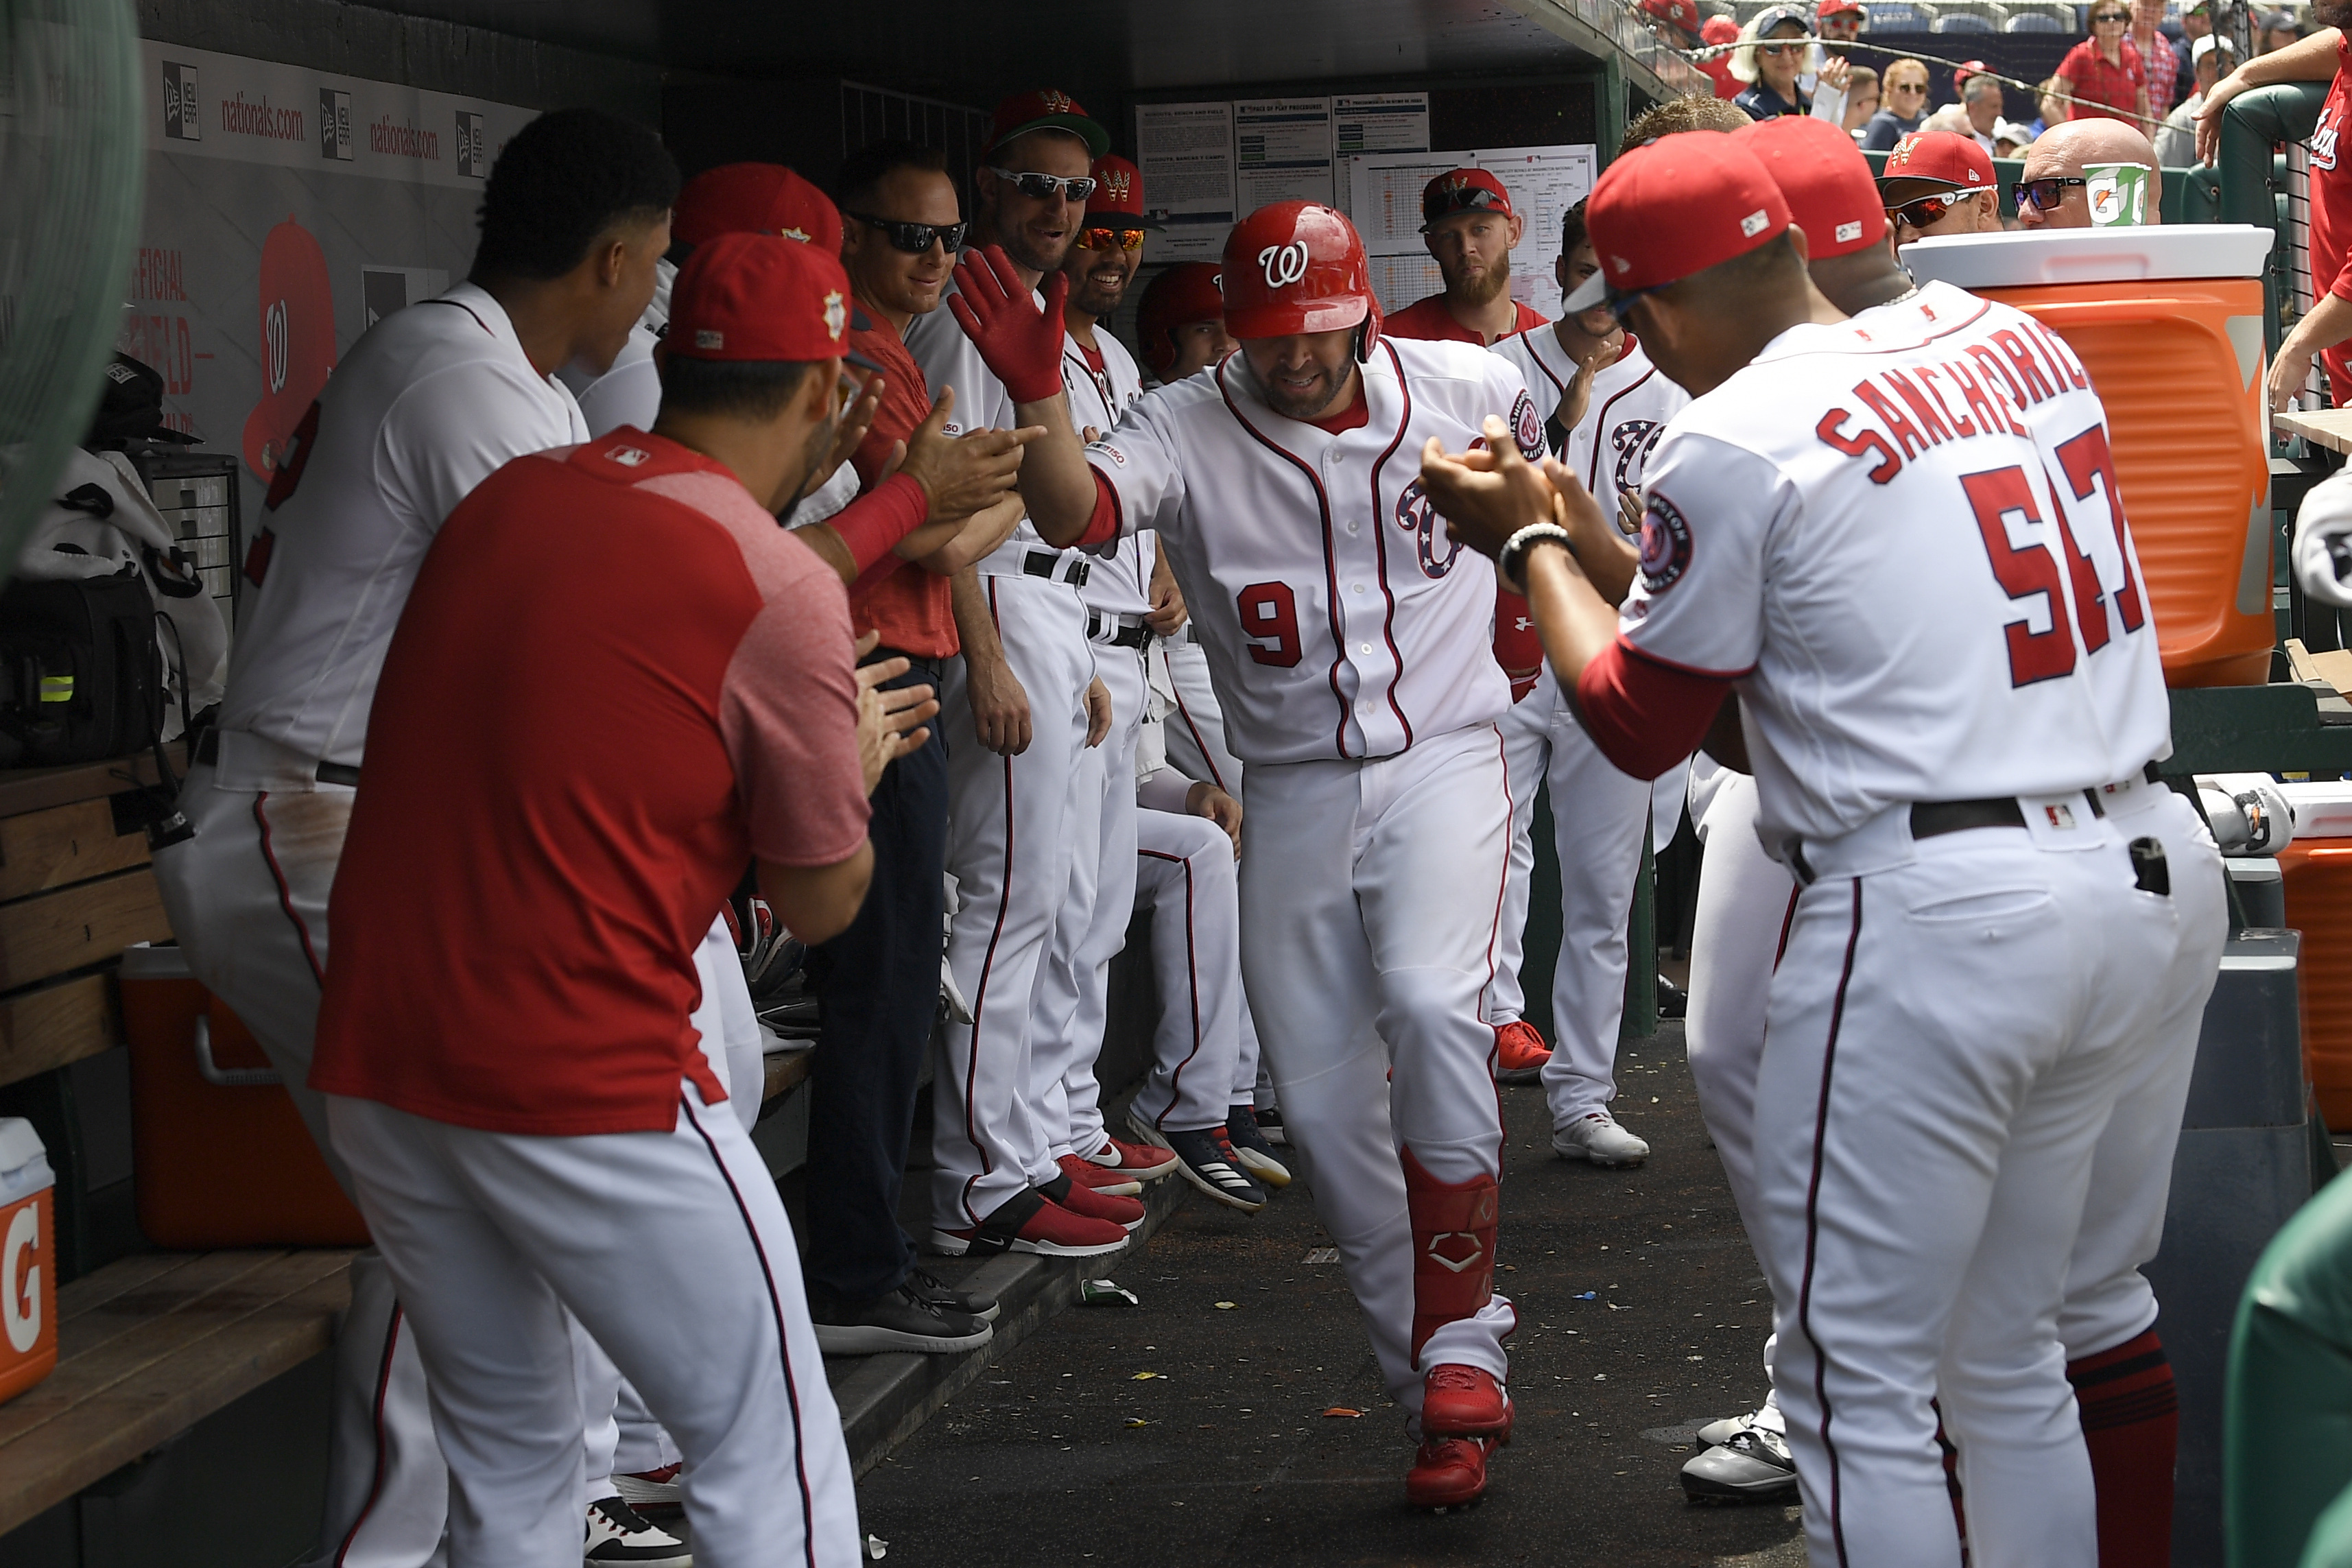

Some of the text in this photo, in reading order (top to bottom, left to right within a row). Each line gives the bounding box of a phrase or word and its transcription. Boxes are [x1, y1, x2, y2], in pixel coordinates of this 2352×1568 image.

[183, 82, 196, 102] NEW
[184, 103, 198, 124] ERA
[222, 91, 304, 141] nationals.com
[337, 106, 349, 126] NEW
[338, 126, 351, 145] ERA
[370, 114, 438, 160] nationals.com
[1100, 170, 1130, 202] W
[2087, 177, 2120, 224] G
[1257, 239, 1309, 289] W
[266, 299, 288, 394] W
[1108, 446, 1125, 464] 150
[1236, 580, 1303, 669] 9
[3, 1200, 43, 1354] G
